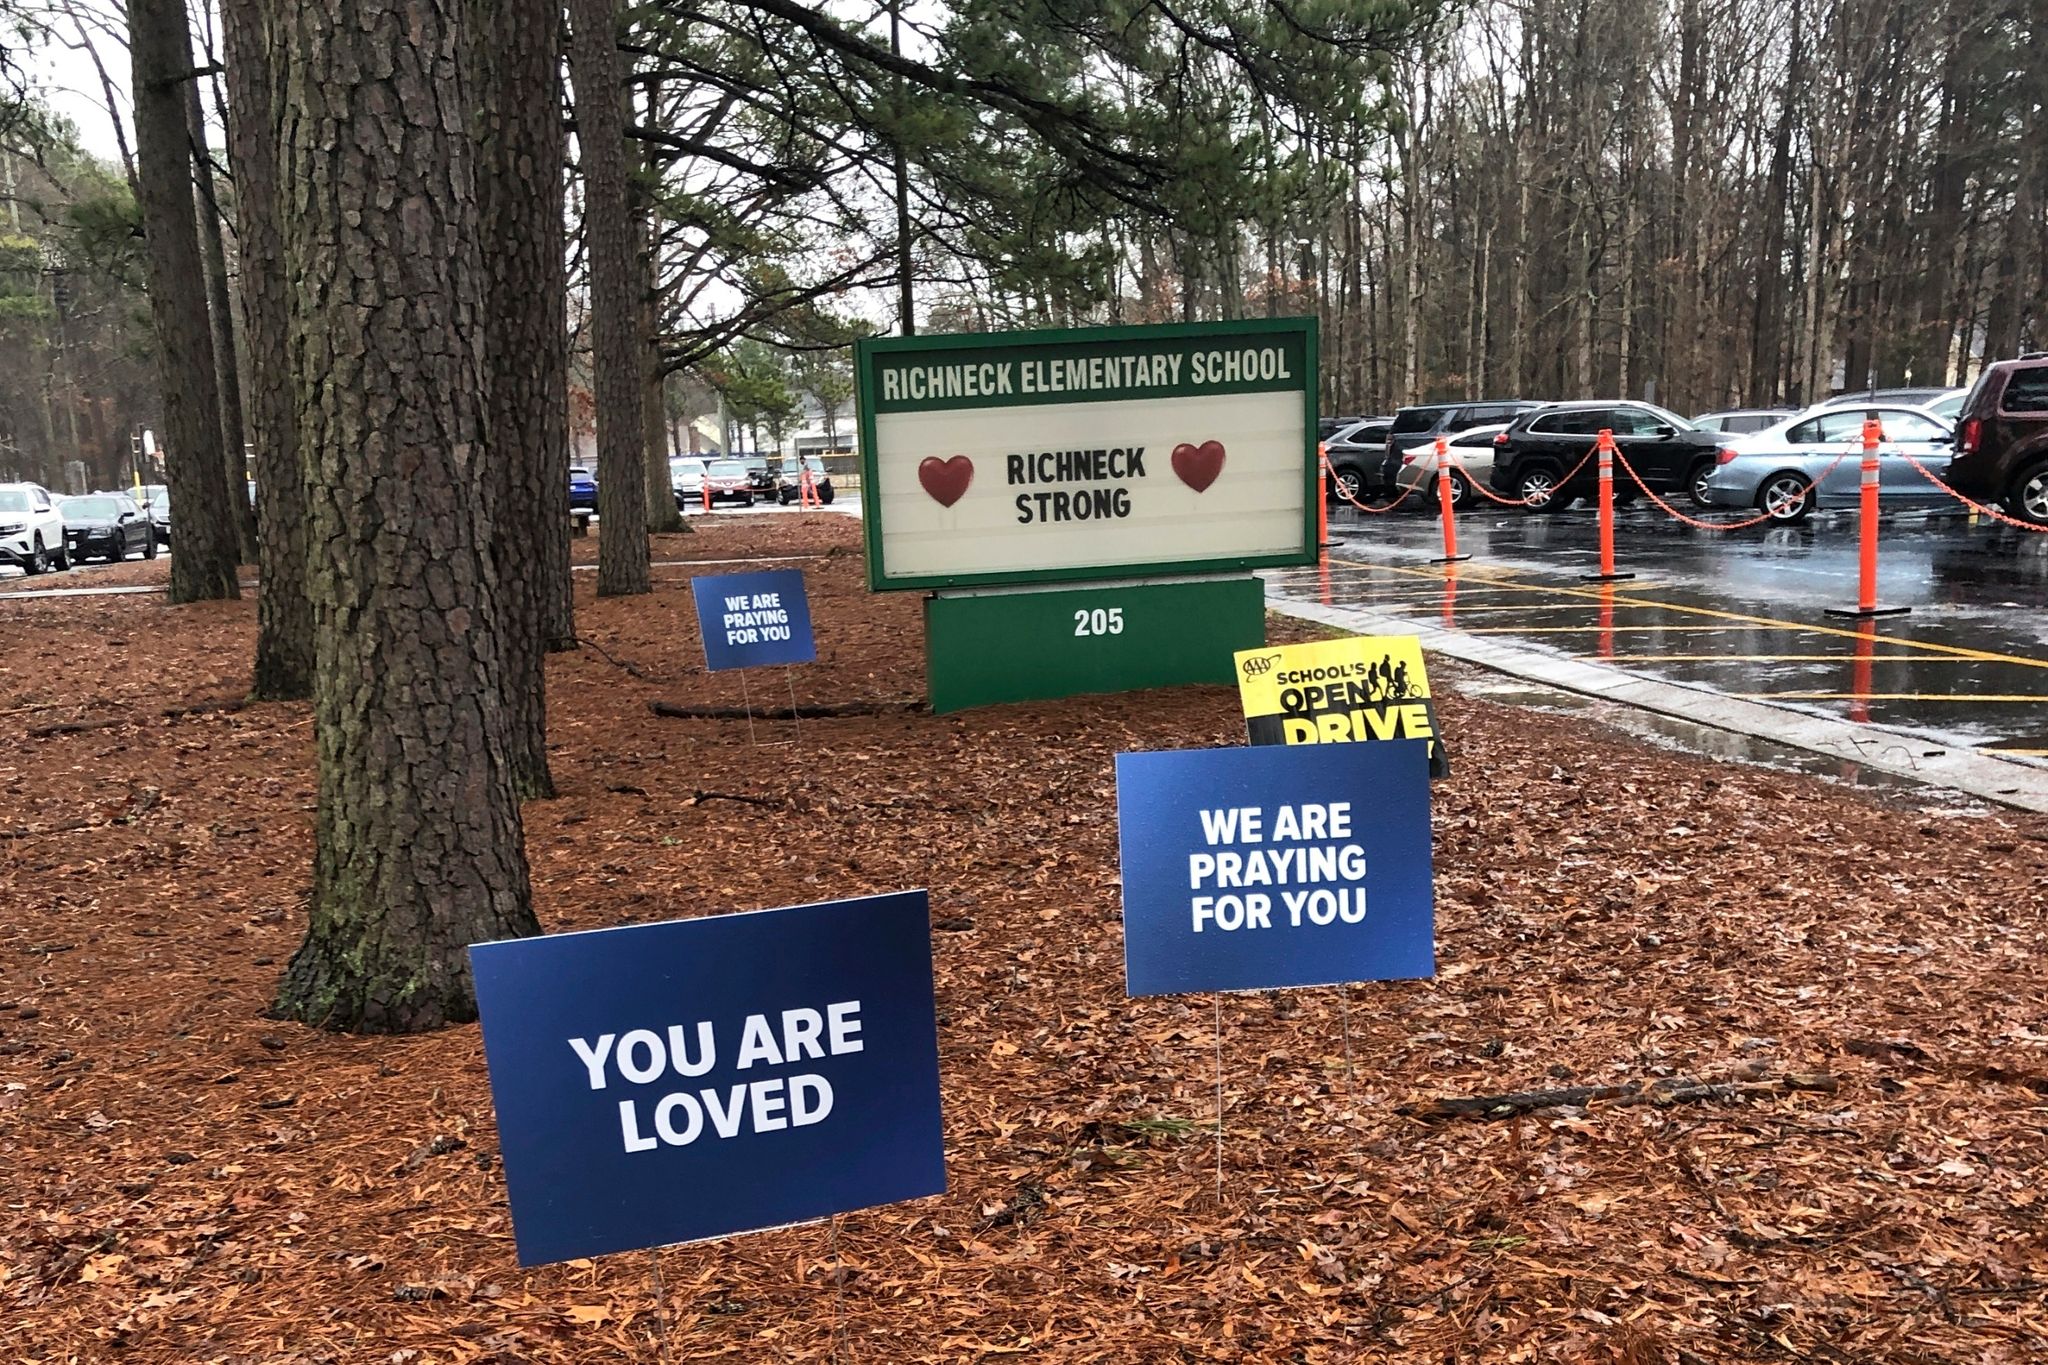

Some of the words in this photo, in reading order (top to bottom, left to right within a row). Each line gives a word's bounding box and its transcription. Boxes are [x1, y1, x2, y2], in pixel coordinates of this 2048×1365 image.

[882, 362, 1013, 401] RICHNECK
[1020, 353, 1183, 394] ELEMENTARY
[1191, 347, 1291, 384] SCHOOL
[1007, 447, 1146, 485] RICHNECK
[1015, 488, 1131, 524] STRONG
[723, 609, 788, 629] PRAYING
[725, 595, 750, 611] WE
[752, 593, 781, 610] ARE
[726, 628, 759, 646] FOR
[759, 625, 791, 642] YOU
[1074, 607, 1124, 637] 205
[1276, 662, 1367, 686] SCHOOL'S
[1280, 679, 1372, 713] OPEN
[1282, 704, 1433, 746] DRIVE
[1199, 807, 1263, 845] WE
[1272, 802, 1352, 842] ARE
[1189, 845, 1367, 889] PRAYING
[1191, 893, 1272, 932] FOR
[1281, 887, 1367, 927] YOU
[567, 1021, 717, 1090] YOU
[736, 1000, 864, 1070] ARE
[618, 1073, 835, 1154] LOVED
